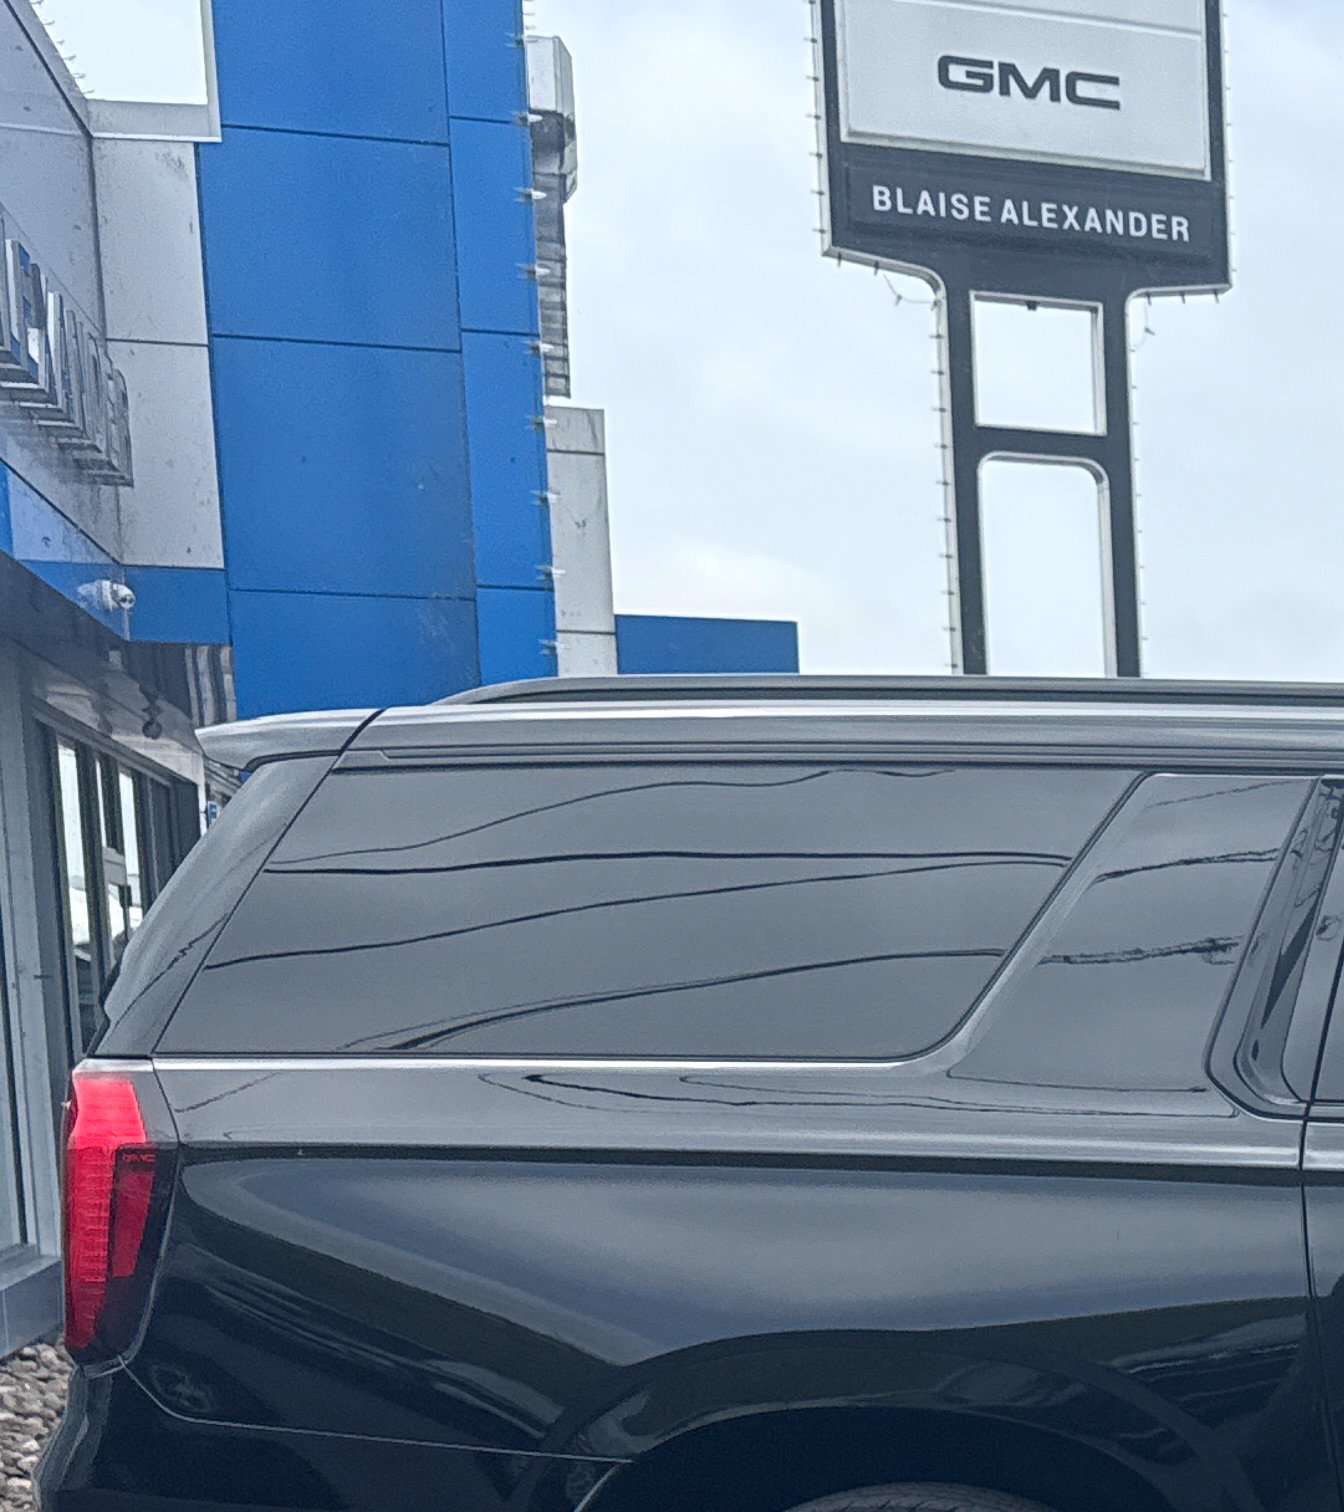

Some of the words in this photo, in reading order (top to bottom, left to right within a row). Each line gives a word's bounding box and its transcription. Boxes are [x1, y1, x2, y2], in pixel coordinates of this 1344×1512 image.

[938, 54, 1120, 110] GMC
[872, 184, 992, 224] BLAISE
[1000, 198, 1190, 243] ALEXANDER
